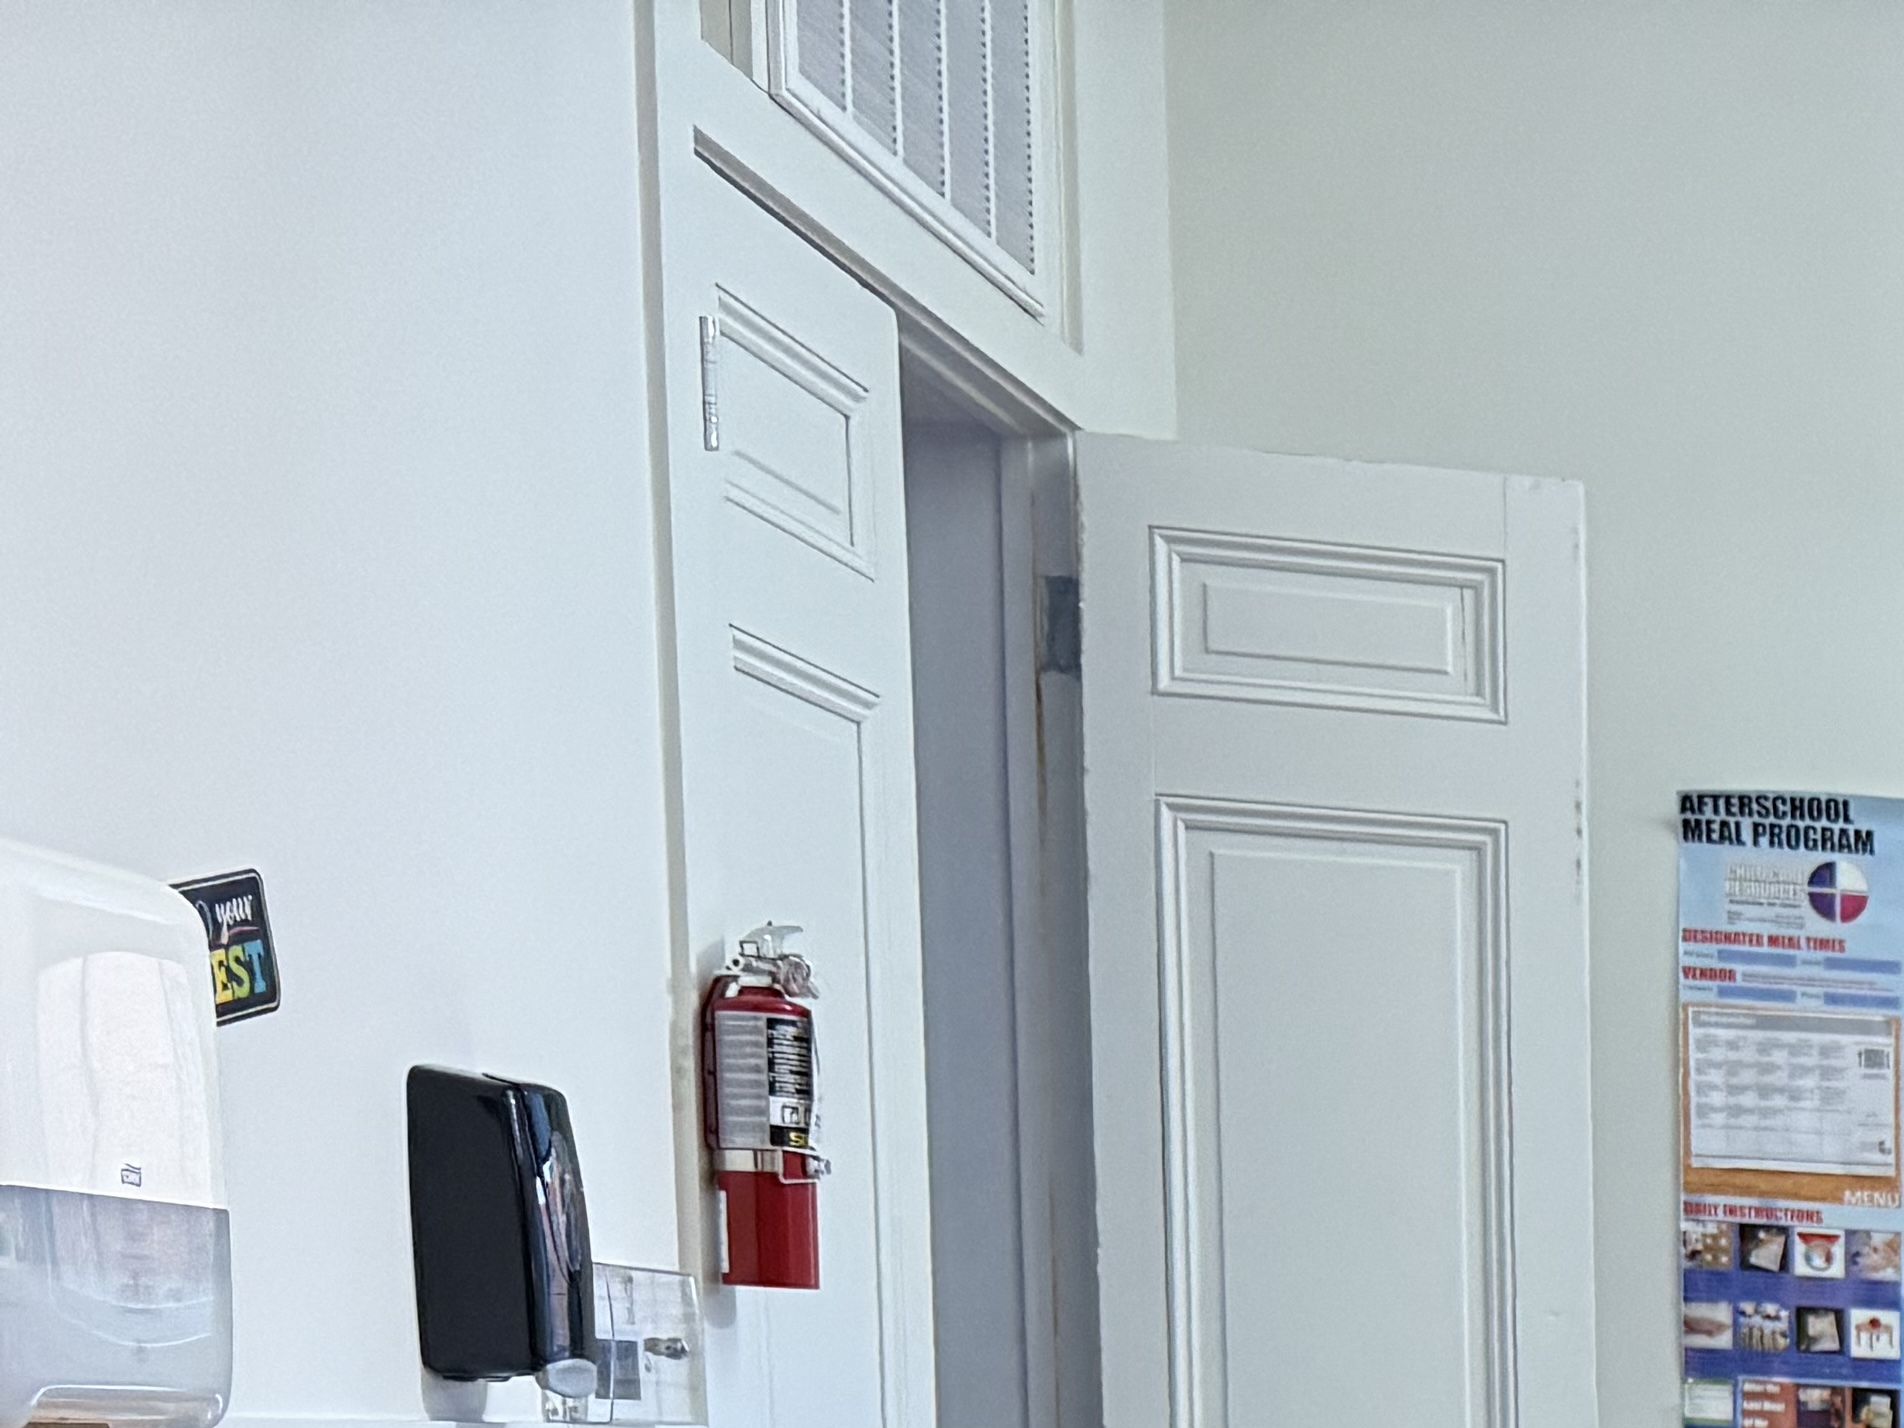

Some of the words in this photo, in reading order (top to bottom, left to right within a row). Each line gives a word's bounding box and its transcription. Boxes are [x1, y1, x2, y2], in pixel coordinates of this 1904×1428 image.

[1680, 794, 1854, 825] AFTERSCHOOL
[1682, 818, 1746, 846] MEAL
[1753, 822, 1875, 856] PROGRAM
[215, 894, 253, 945] your
[1682, 928, 1764, 947] DESIGNATED
[1767, 934, 1804, 950] MEAL
[1805, 936, 1847, 953] TIMES
[210, 939, 267, 1004] EST
[1681, 965, 1737, 983] VENDOR
[1844, 1189, 1900, 1208] MENU
